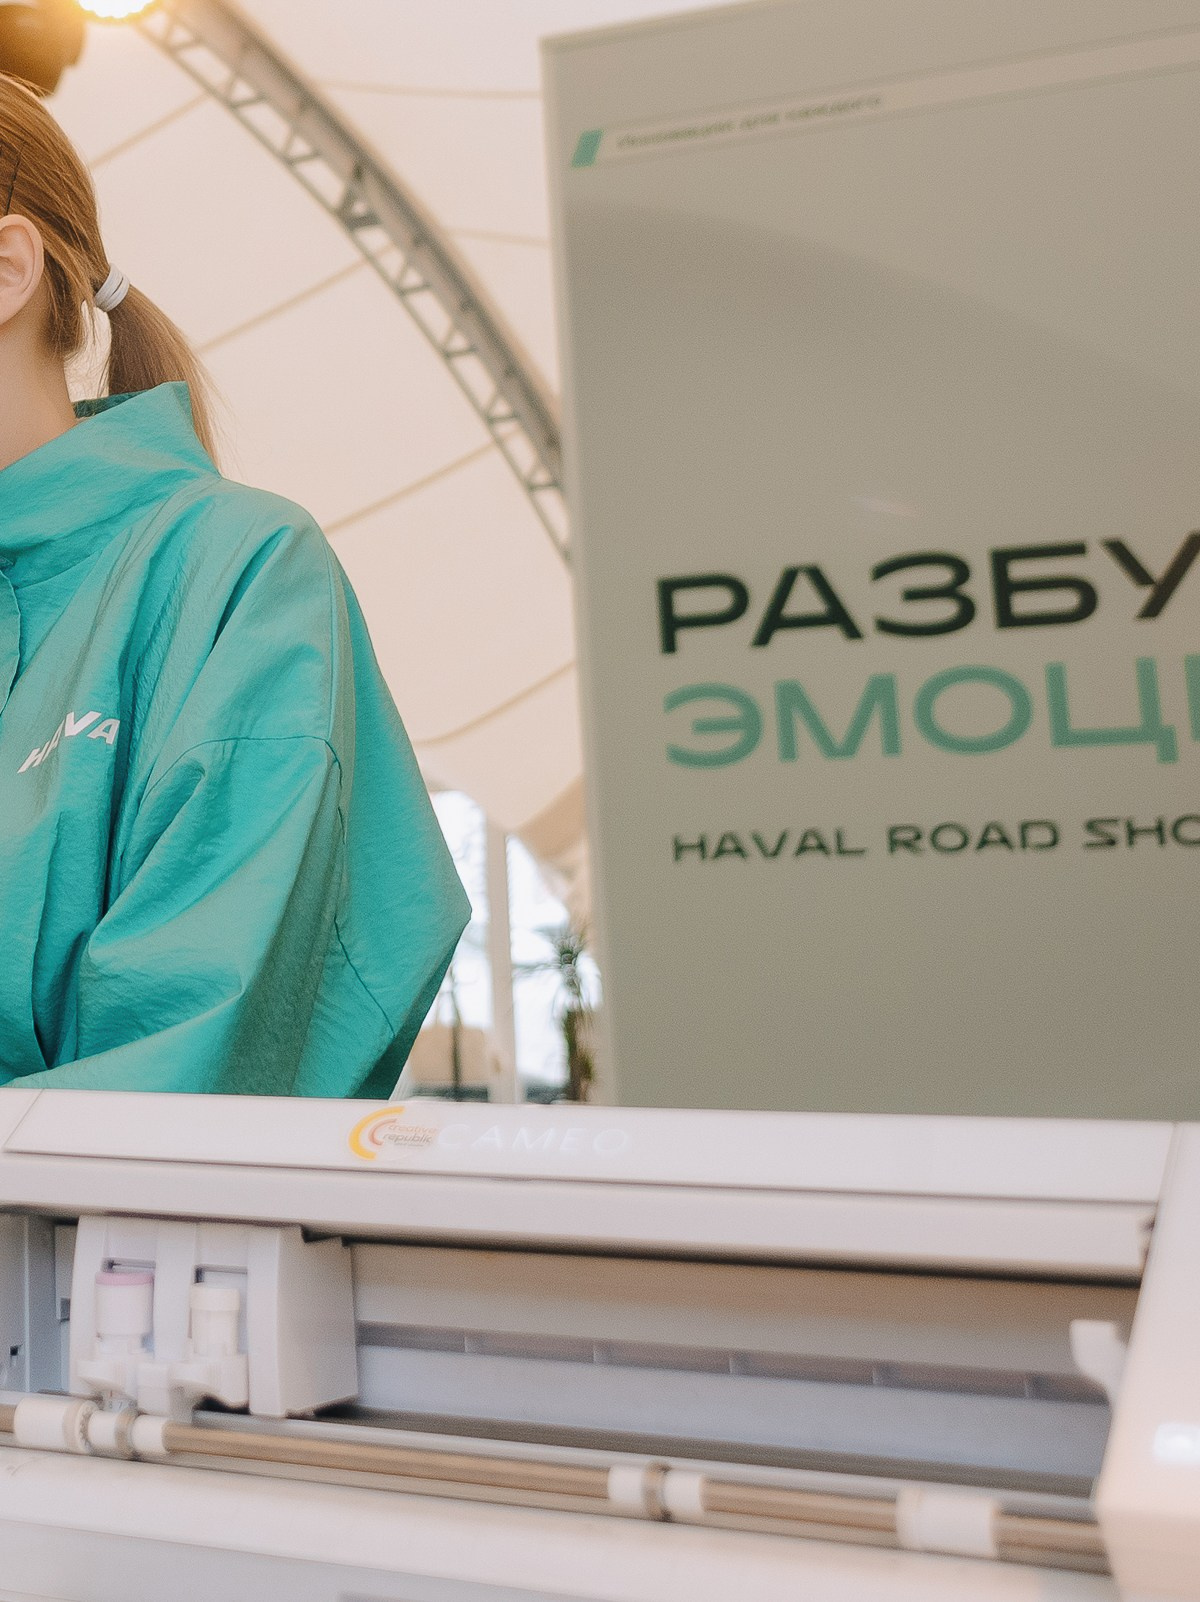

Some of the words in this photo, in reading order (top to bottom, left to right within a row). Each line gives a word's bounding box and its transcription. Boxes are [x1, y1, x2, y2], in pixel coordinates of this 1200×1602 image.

[656, 530, 1200, 655] РАЗБУ
[663, 653, 1200, 770] ЭМОЦ
[672, 826, 868, 863] HAVAL
[886, 818, 1060, 856] ROAD
[1083, 813, 1200, 851] SHO
[438, 1122, 629, 1157] CAMEO
